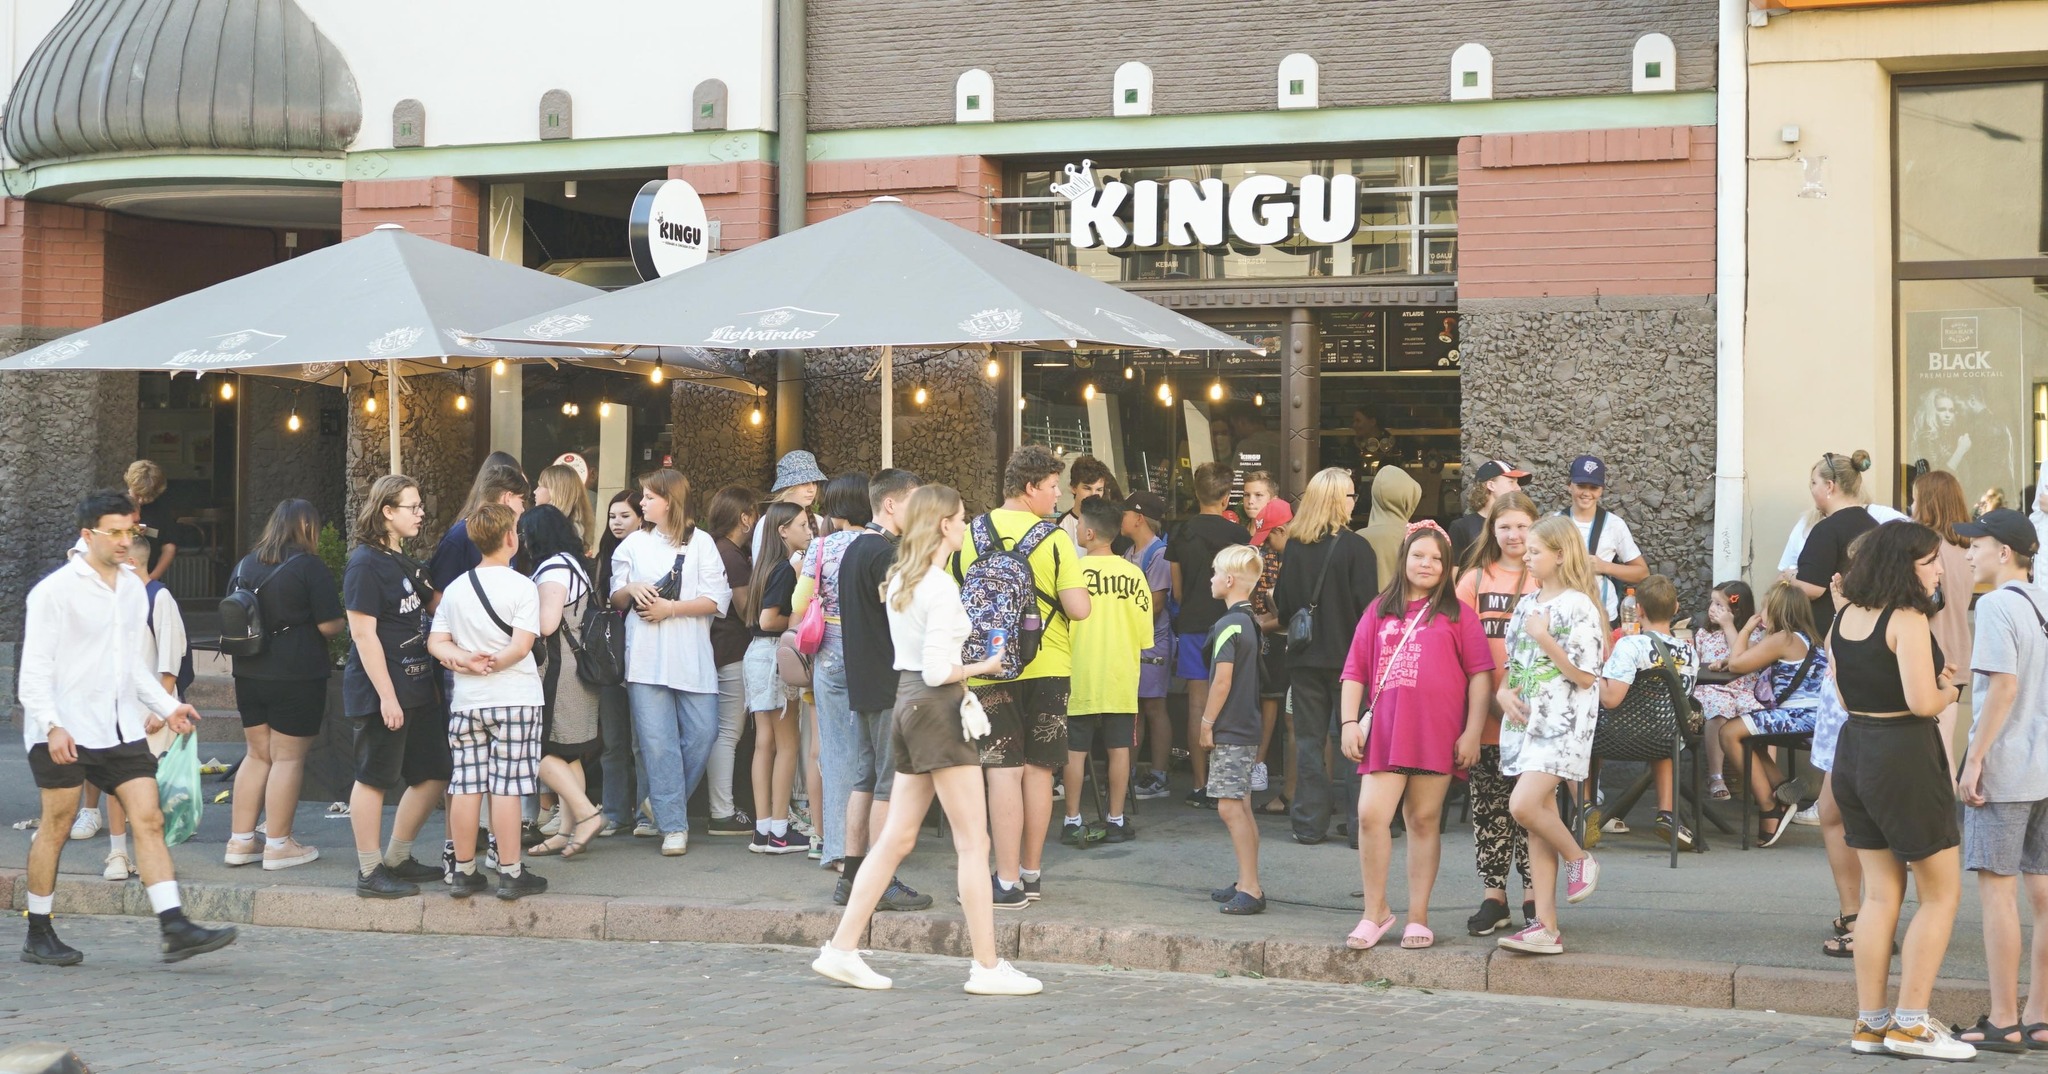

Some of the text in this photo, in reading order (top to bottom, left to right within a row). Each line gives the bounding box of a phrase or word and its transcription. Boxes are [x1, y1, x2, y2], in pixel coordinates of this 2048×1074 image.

[1070, 174, 1361, 248] KINGU
[660, 221, 701, 245] KINGU
[1929, 351, 1992, 370] BLACK
[1488, 595, 1508, 609] MY
[1483, 620, 1499, 635] MY
